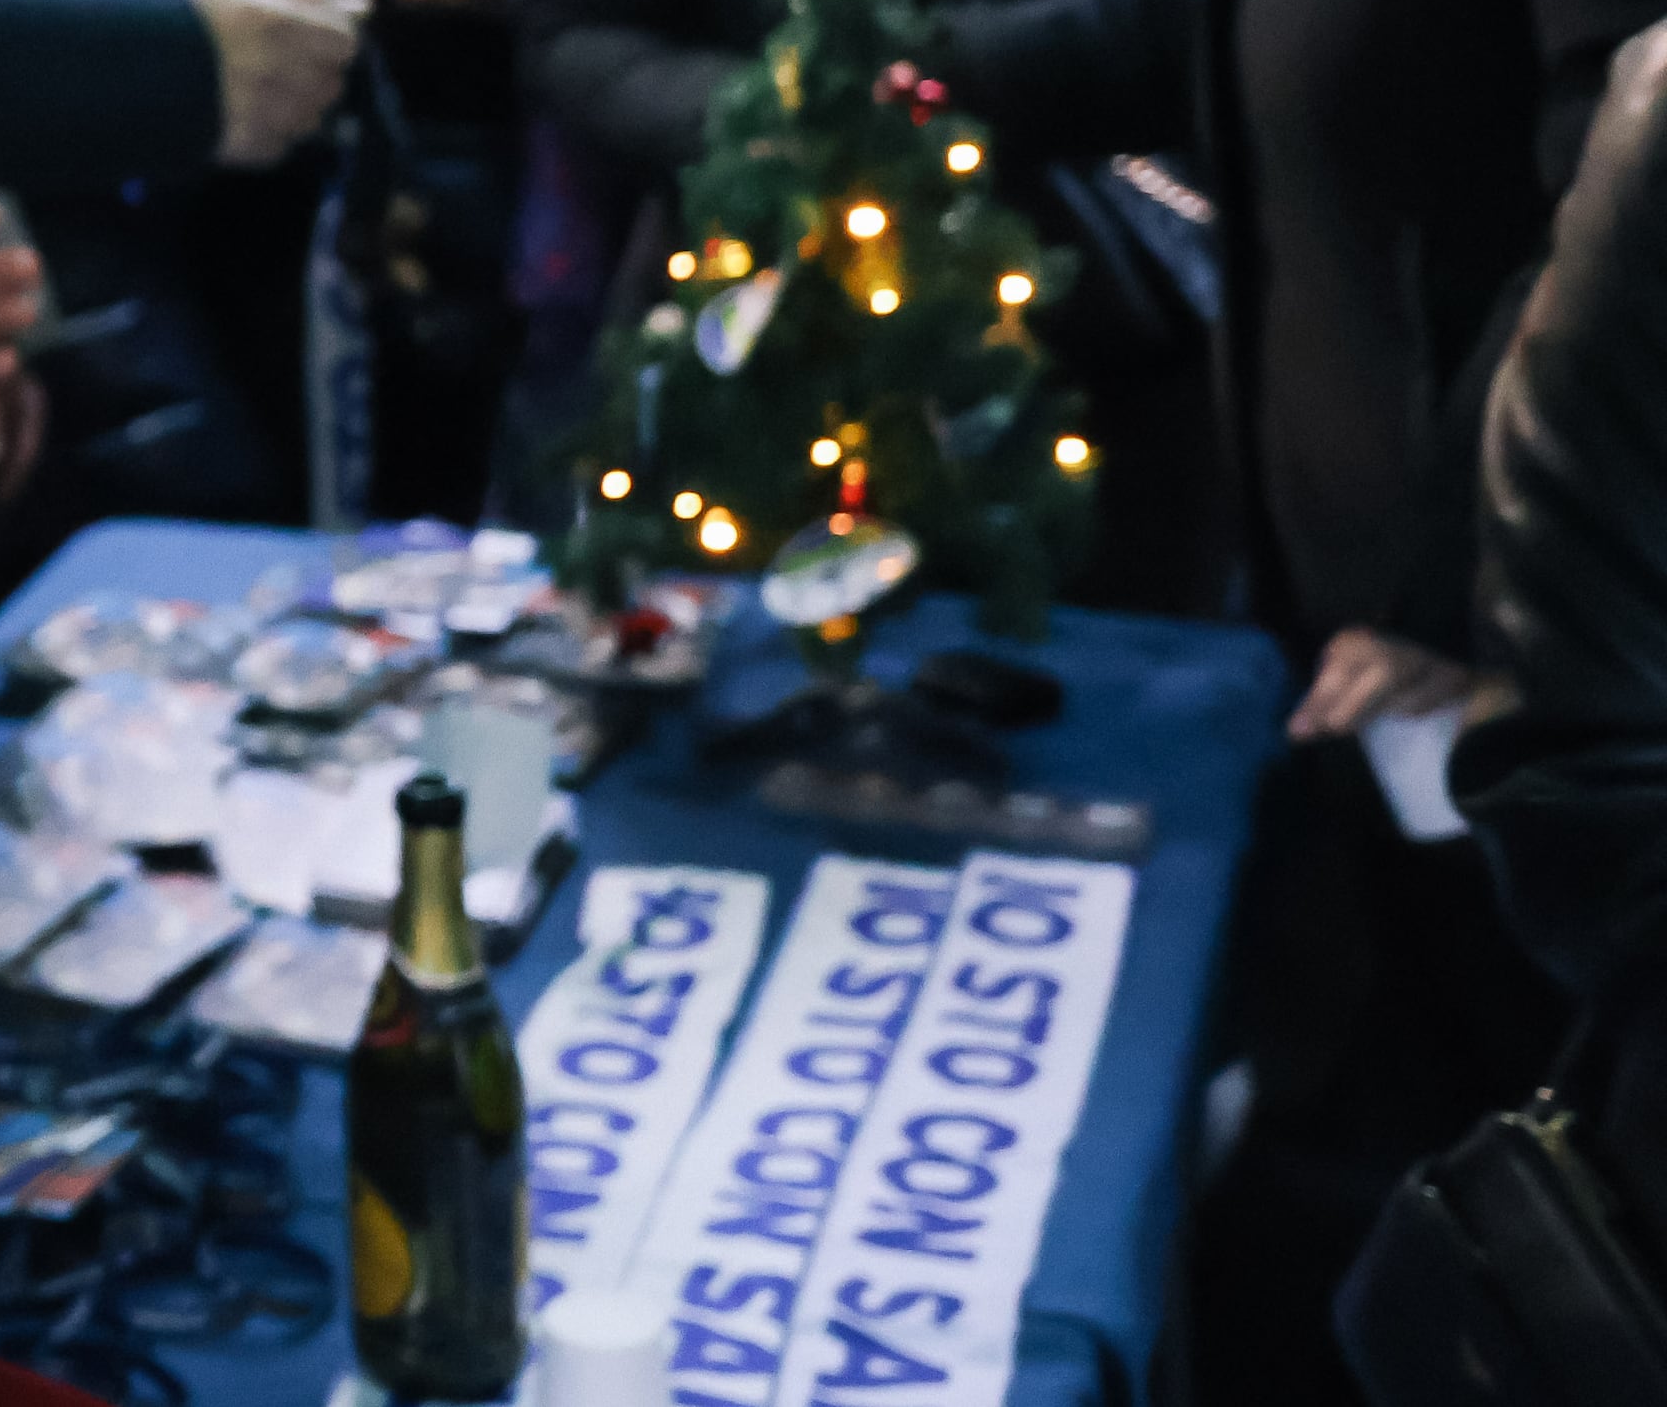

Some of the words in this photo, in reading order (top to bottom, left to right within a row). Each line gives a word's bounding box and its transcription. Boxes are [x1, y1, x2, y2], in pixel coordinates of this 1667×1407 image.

[968, 870, 1080, 949] IO
[784, 961, 925, 1085] STO
[924, 960, 1063, 1091] STO
[704, 1105, 862, 1248] CON
[856, 1108, 1019, 1261] CON
[811, 1277, 965, 1407] SA
